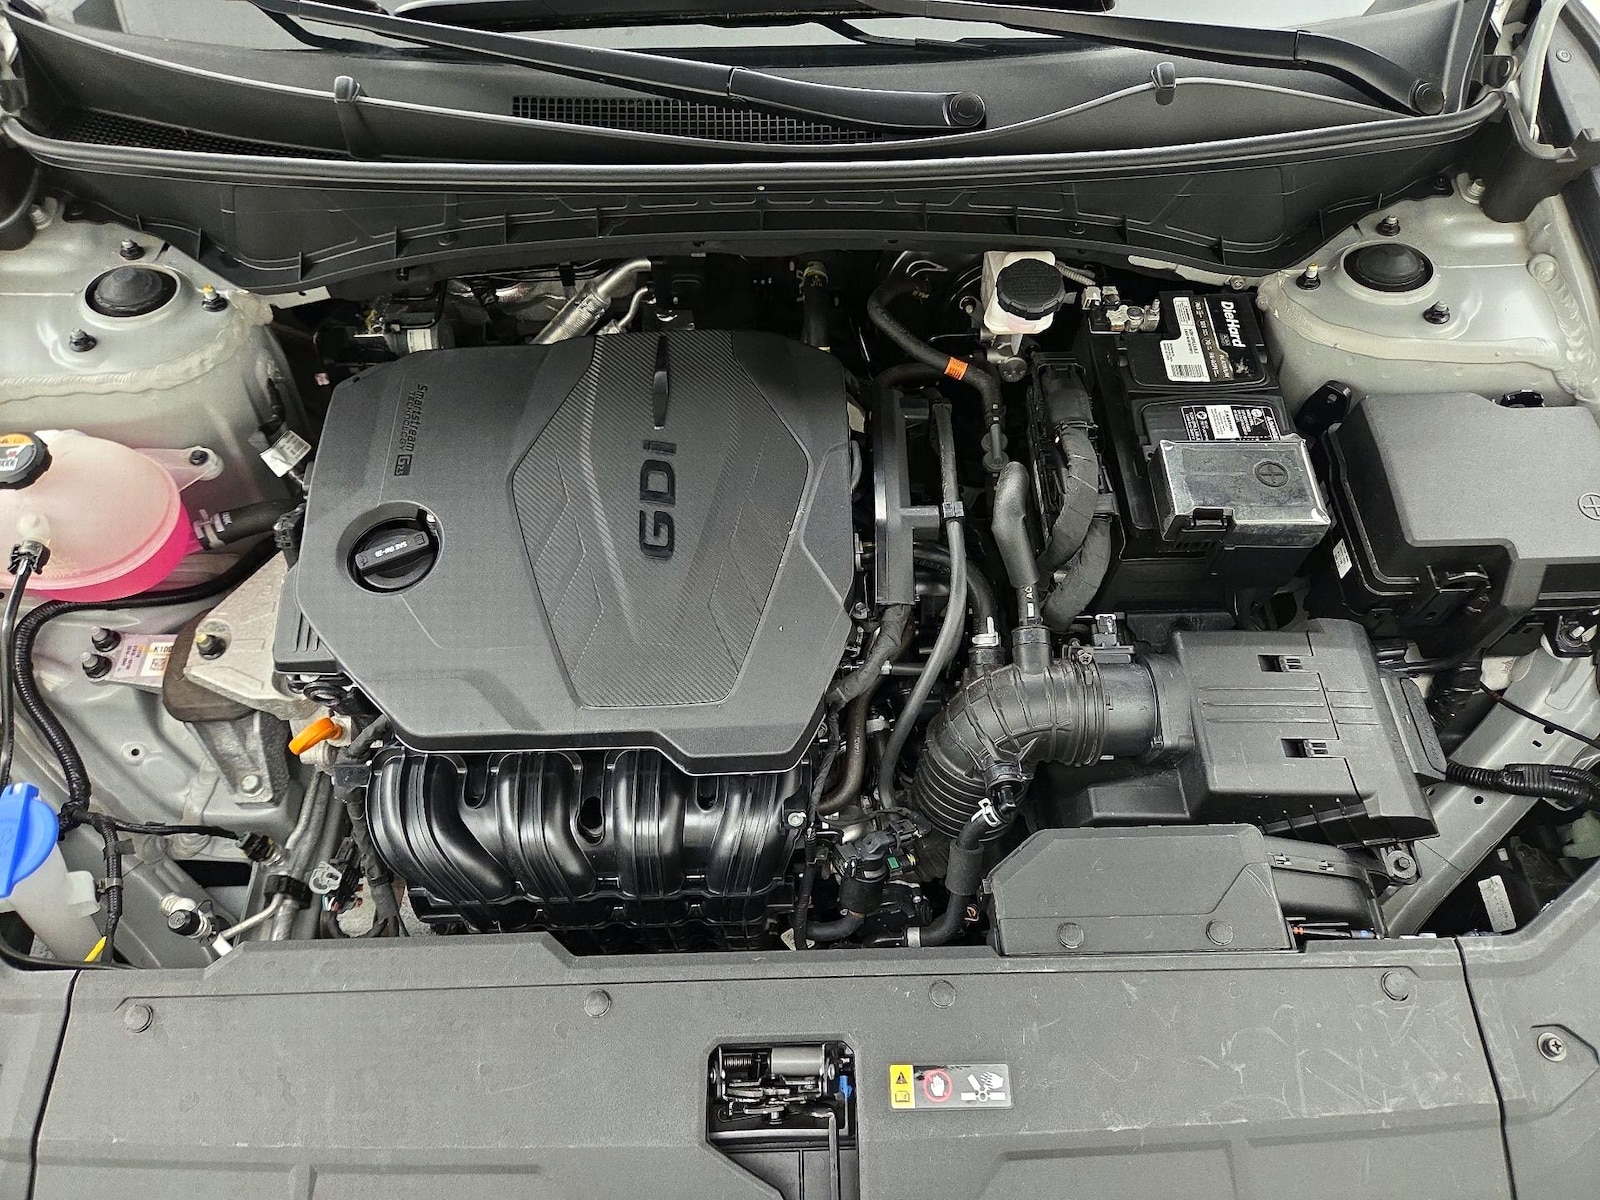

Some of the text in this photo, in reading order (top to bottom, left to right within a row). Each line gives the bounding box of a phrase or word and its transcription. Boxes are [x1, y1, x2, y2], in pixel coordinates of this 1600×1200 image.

[1221, 301, 1246, 348] DieHard
[400, 391, 416, 451] TECHNOLOGY
[406, 384, 428, 452] Smartstream
